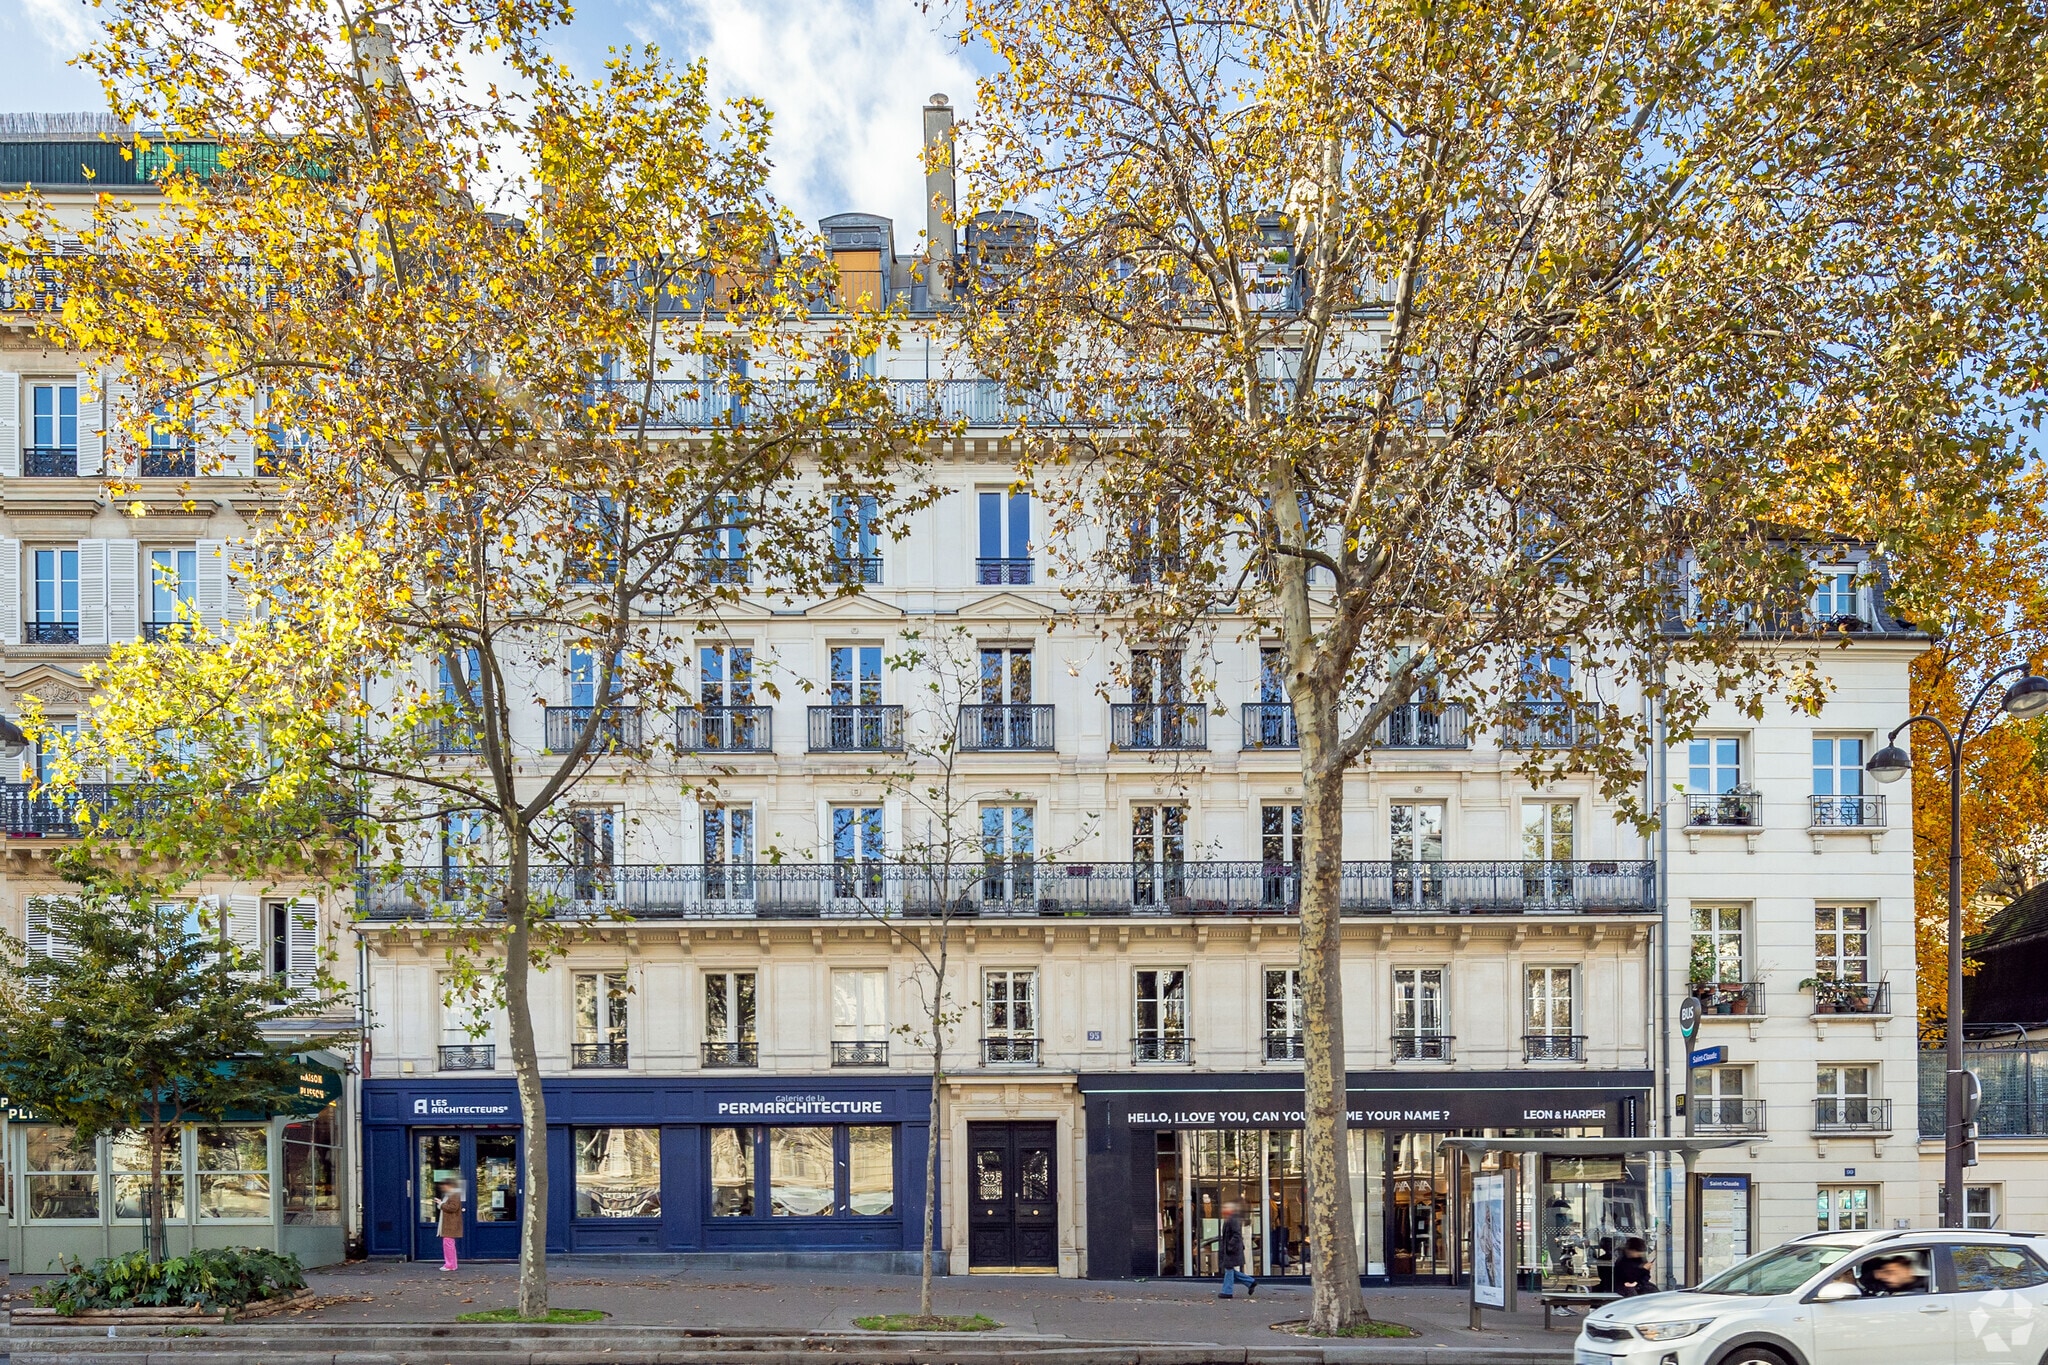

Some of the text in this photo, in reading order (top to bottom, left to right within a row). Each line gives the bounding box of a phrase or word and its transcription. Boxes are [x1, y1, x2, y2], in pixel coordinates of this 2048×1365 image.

[1681, 1006, 1694, 1020] BUS
[1089, 1031, 1100, 1040] 95
[1692, 1052, 1718, 1063] Saint-Claude
[431, 1099, 448, 1107] LES
[718, 1101, 882, 1114] PERMARCHITECTURE
[1127, 1112, 1172, 1124] HELLO,
[1174, 1112, 1179, 1122] I
[1182, 1112, 1216, 1123] LOVE
[1219, 1111, 1250, 1123] YOU,
[1252, 1111, 1279, 1121] CAN
[1345, 1111, 1363, 1120] ME
[1366, 1110, 1401, 1121] YOUR
[1404, 1110, 1440, 1120] NAME
[1523, 1110, 1606, 1119] LEON & HARPER
